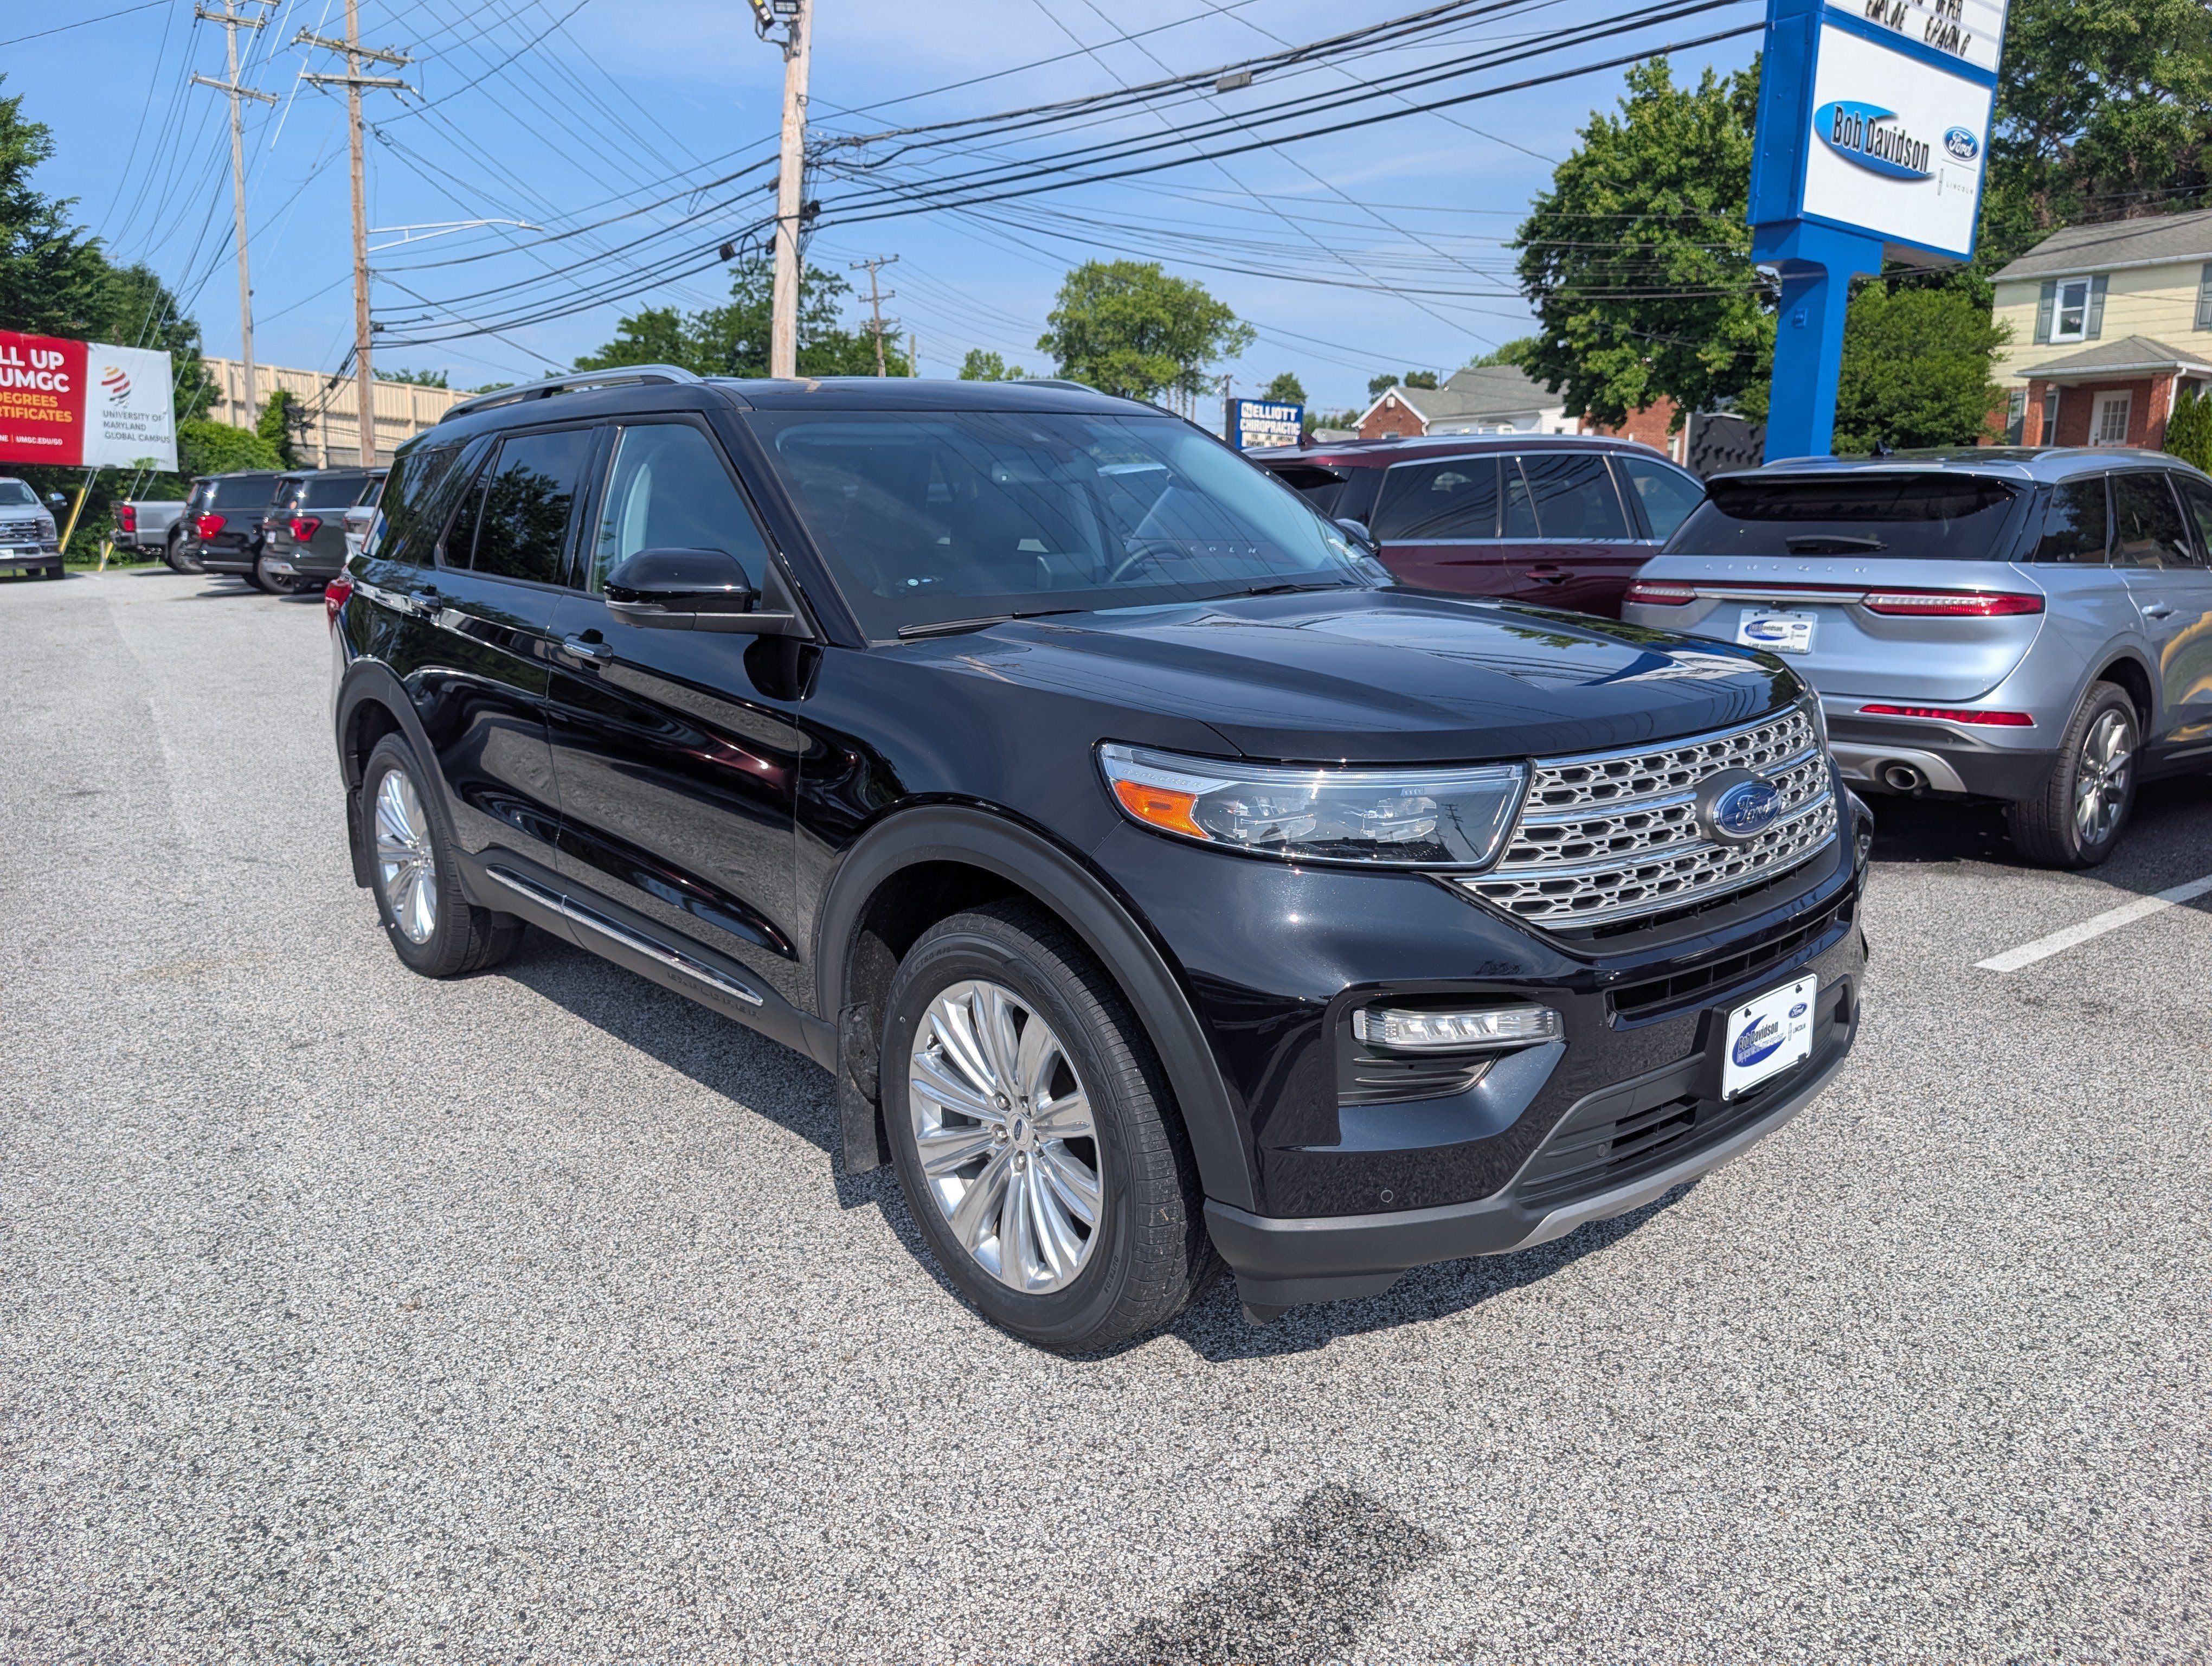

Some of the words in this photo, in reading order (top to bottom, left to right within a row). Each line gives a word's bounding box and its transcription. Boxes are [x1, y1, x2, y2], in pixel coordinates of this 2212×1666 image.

[1831, 104, 1862, 152] Bob
[1864, 115, 1930, 174] Davidson
[1949, 131, 1975, 157] Ford
[30, 349, 65, 370] UP
[0, 367, 70, 393] UMGC
[0, 405, 73, 423] TIFICATES
[102, 409, 150, 421] UNIVERSITY
[1252, 403, 1298, 421] ELLIOTT
[103, 420, 146, 431] MARYLAND
[1239, 418, 1301, 436] CHIROPRACTIC
[104, 431, 137, 441] GLOBAL
[138, 433, 171, 444] CAMPUS
[1121, 768, 1204, 788] EXPLORER
[1735, 792, 1772, 826] Ford
[667, 972, 760, 1020] EXPLORER
[1791, 1005, 1805, 1017] Ford
[1738, 1032, 1751, 1052] Bob
[1751, 1021, 1779, 1045] Davidson
